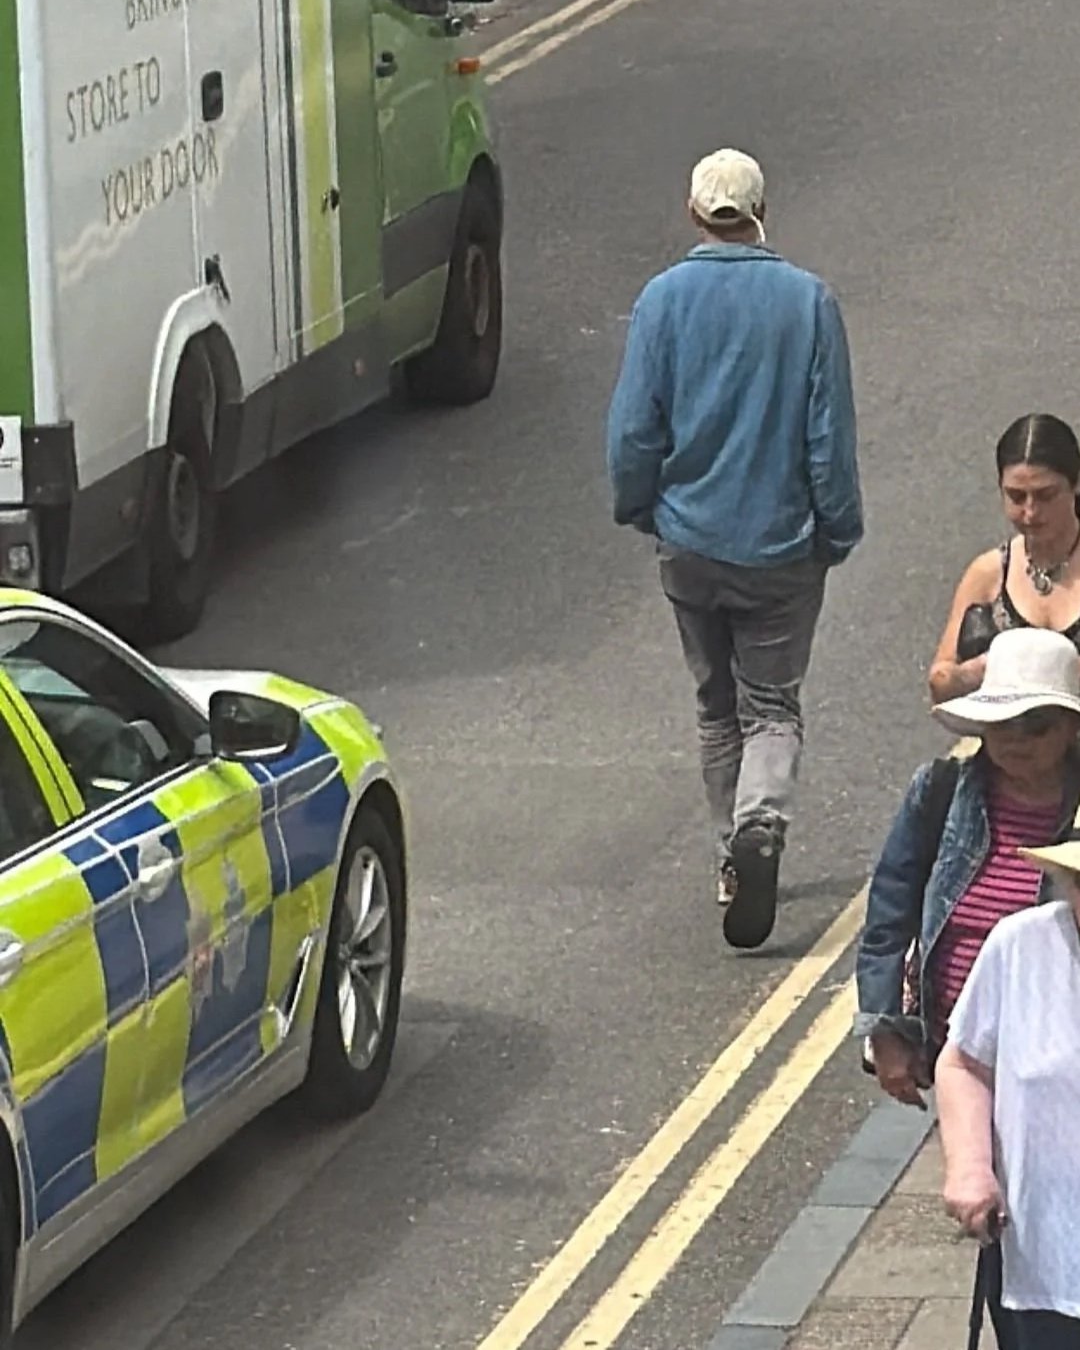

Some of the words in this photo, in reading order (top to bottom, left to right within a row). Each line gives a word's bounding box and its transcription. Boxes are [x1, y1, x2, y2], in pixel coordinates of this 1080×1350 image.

[67, 66, 129, 143] STORE
[135, 57, 160, 112] TO
[101, 156, 155, 225] YOUR
[161, 127, 219, 199] DOOR
